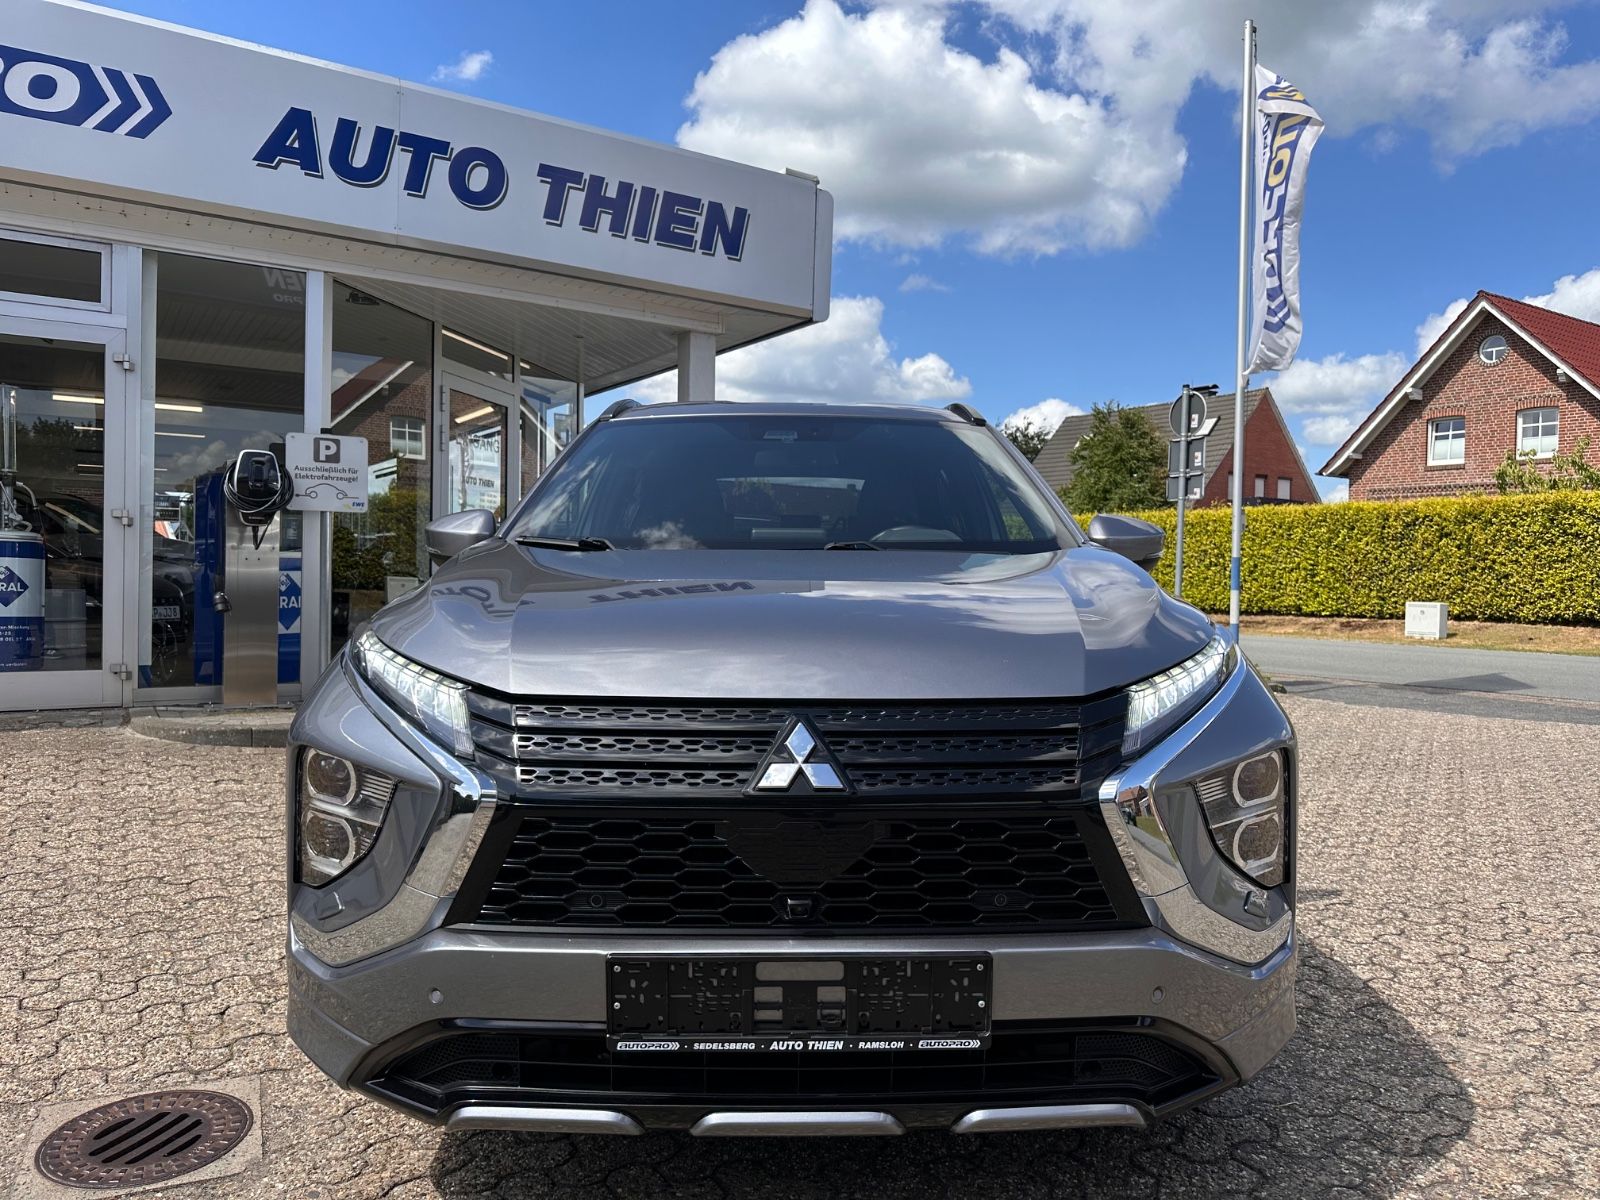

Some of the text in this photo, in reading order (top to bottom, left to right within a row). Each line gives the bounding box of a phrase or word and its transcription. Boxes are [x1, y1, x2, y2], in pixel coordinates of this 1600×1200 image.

[252, 106, 750, 262] AUTO THIEN
[320, 440, 337, 461] P
[295, 465, 358, 475] Ausschließlich für
[693, 1042, 756, 1050] SEDELSBERG
[769, 1041, 803, 1050] AUTO
[807, 1041, 844, 1050] THIEN
[858, 1041, 904, 1049] RAMSLOH
